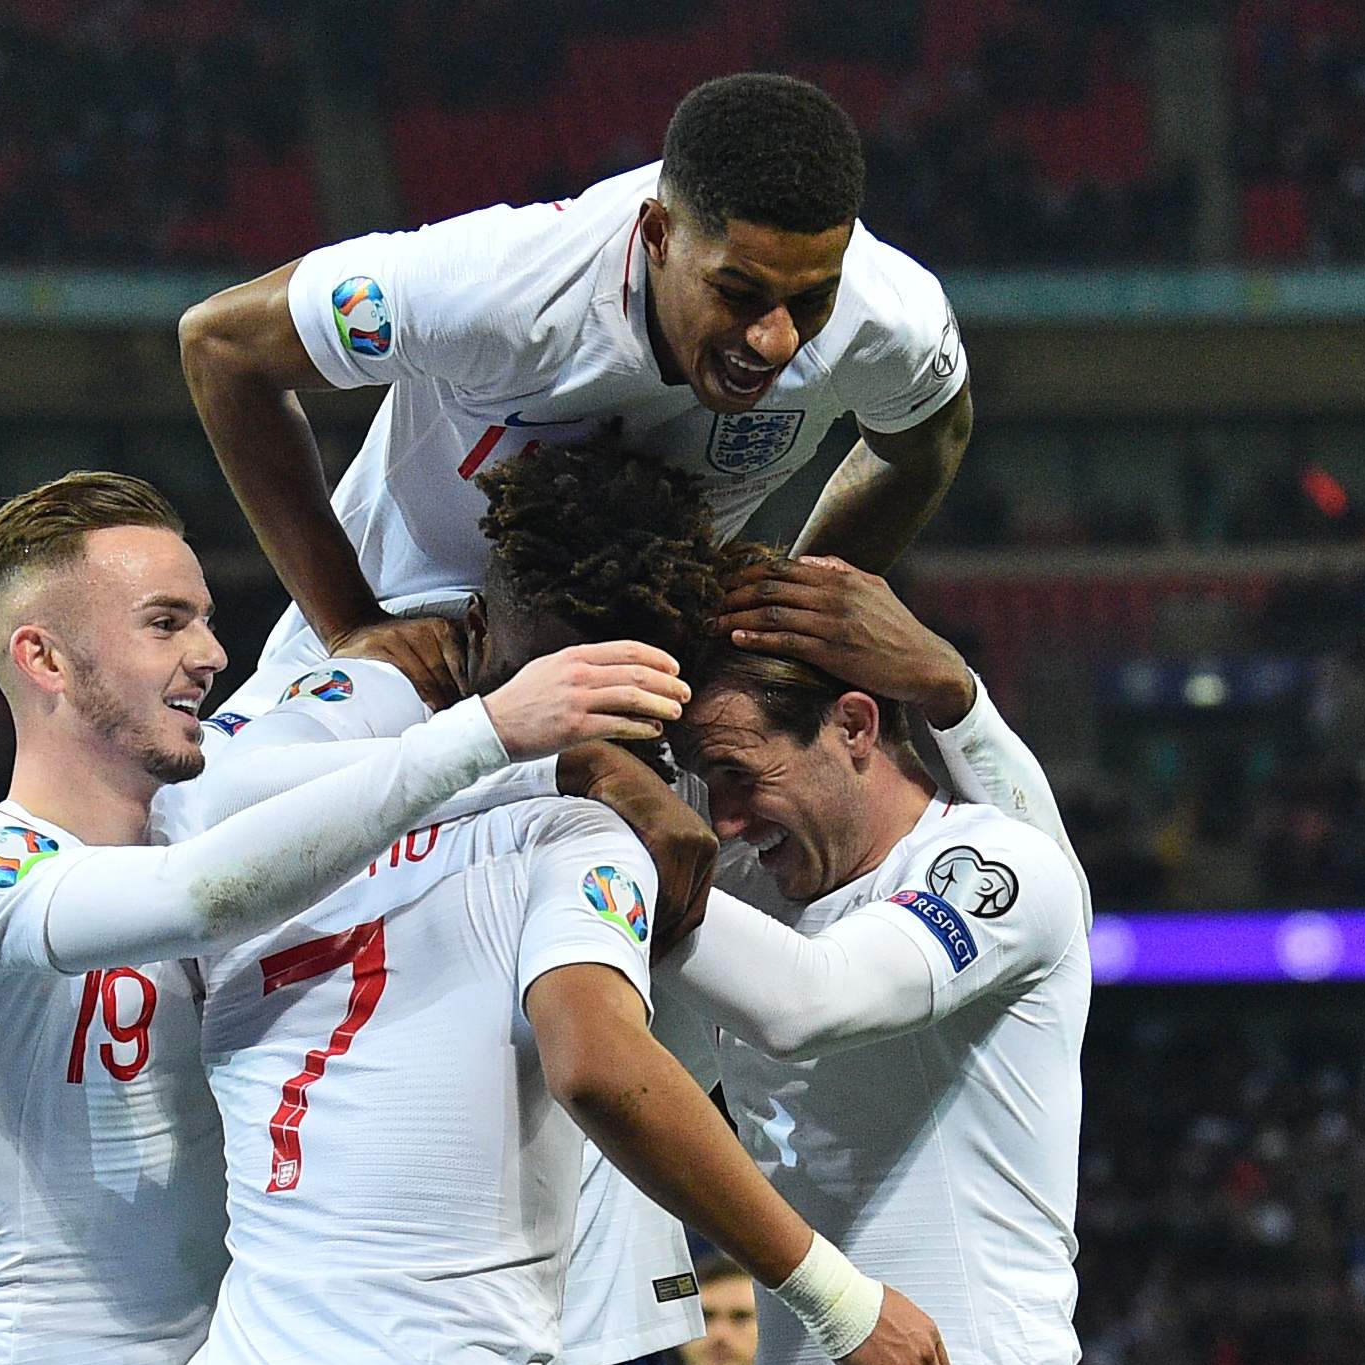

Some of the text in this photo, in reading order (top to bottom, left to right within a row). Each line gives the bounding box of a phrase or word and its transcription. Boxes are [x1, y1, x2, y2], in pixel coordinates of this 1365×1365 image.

[911, 897, 973, 963] RESPECT
[66, 966, 158, 1085] 19
[258, 915, 387, 1194] 7
